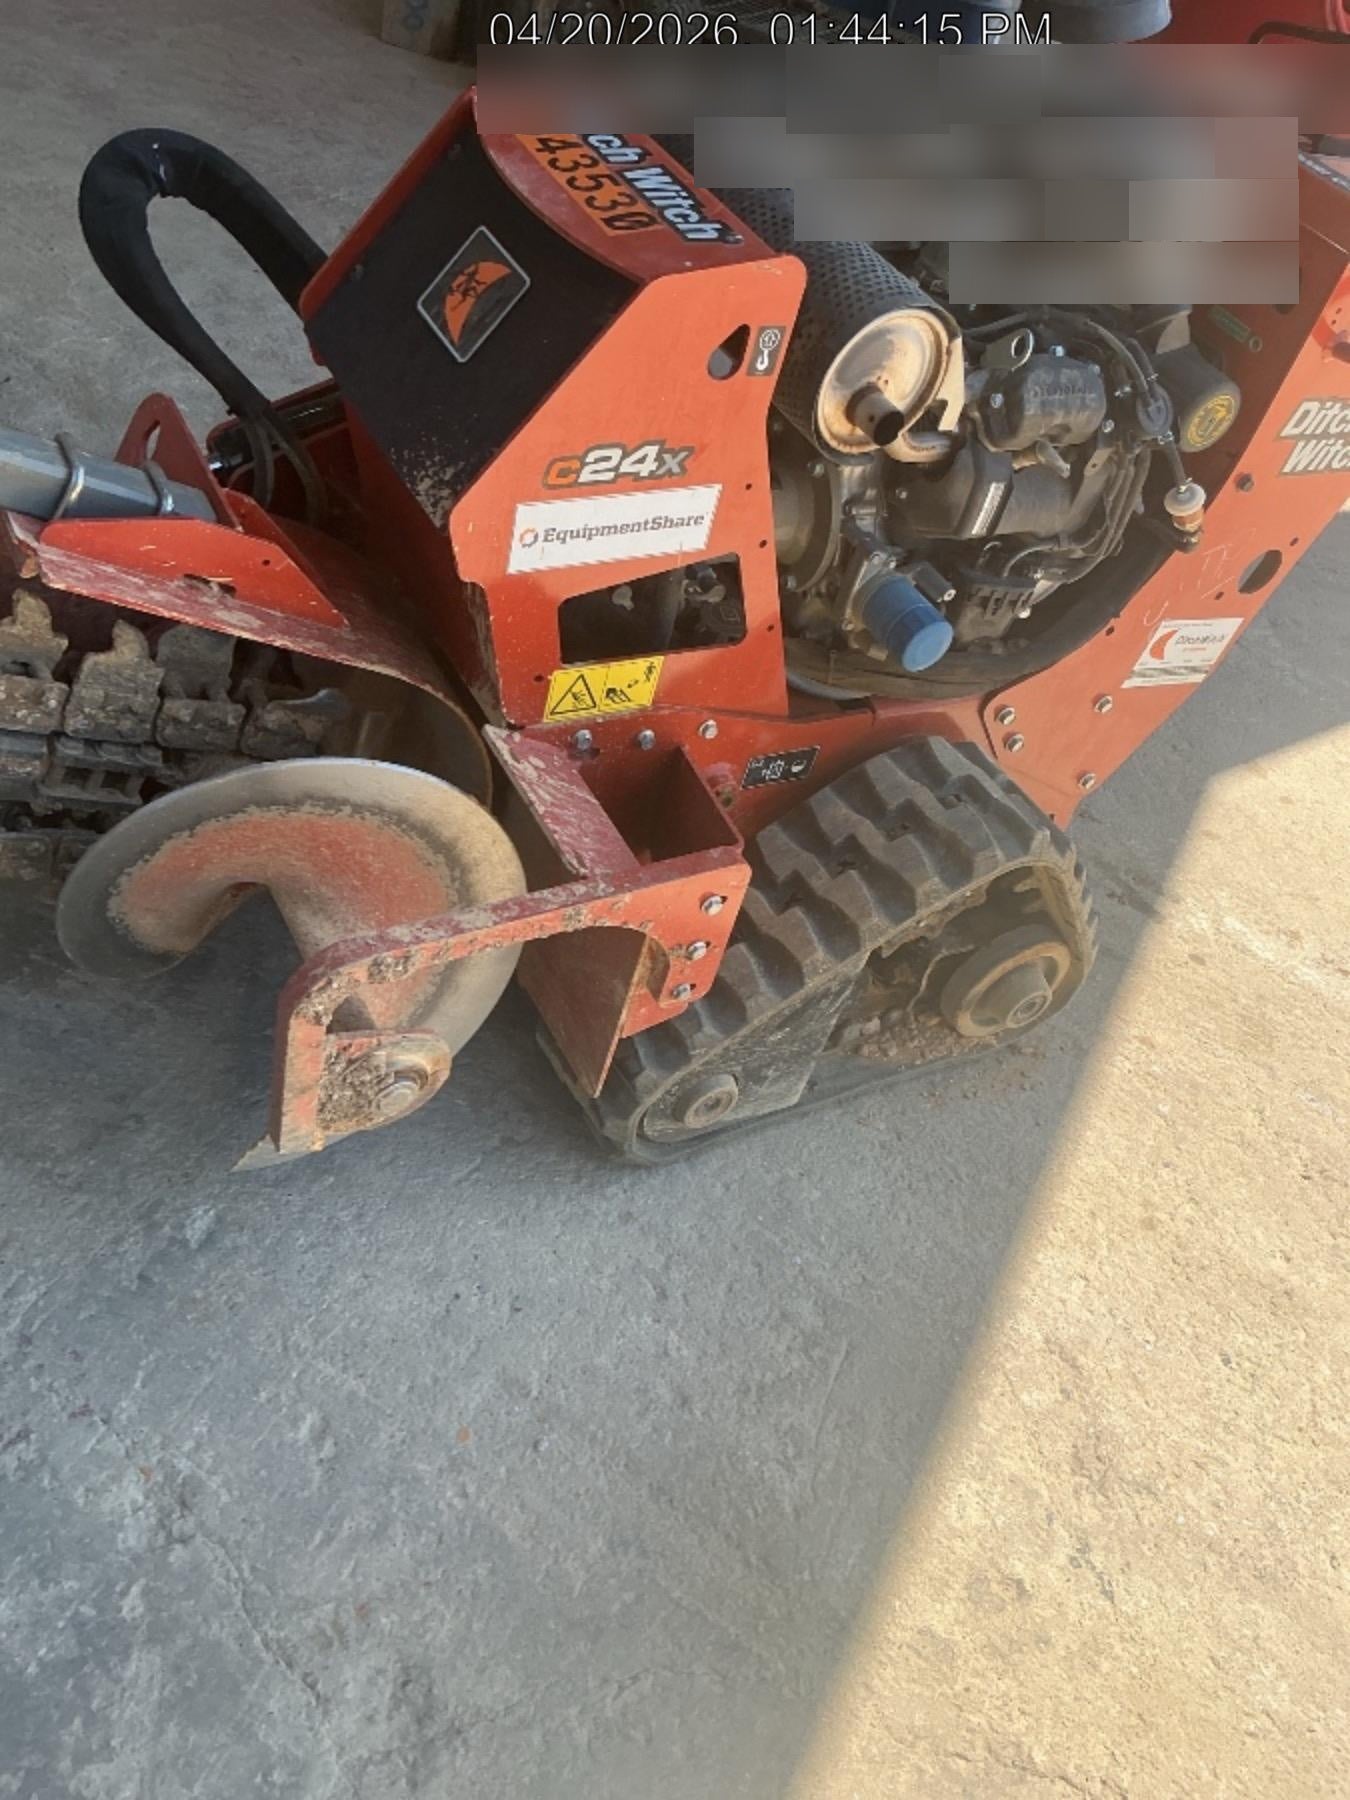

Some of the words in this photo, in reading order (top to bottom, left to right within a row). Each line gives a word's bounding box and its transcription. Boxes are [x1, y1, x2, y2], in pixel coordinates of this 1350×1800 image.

[622, 166, 722, 240] Witch
[1279, 400, 1350, 437] Ditc
[1281, 437, 1350, 473] Witc
[541, 512, 705, 546] EquipmentShare
